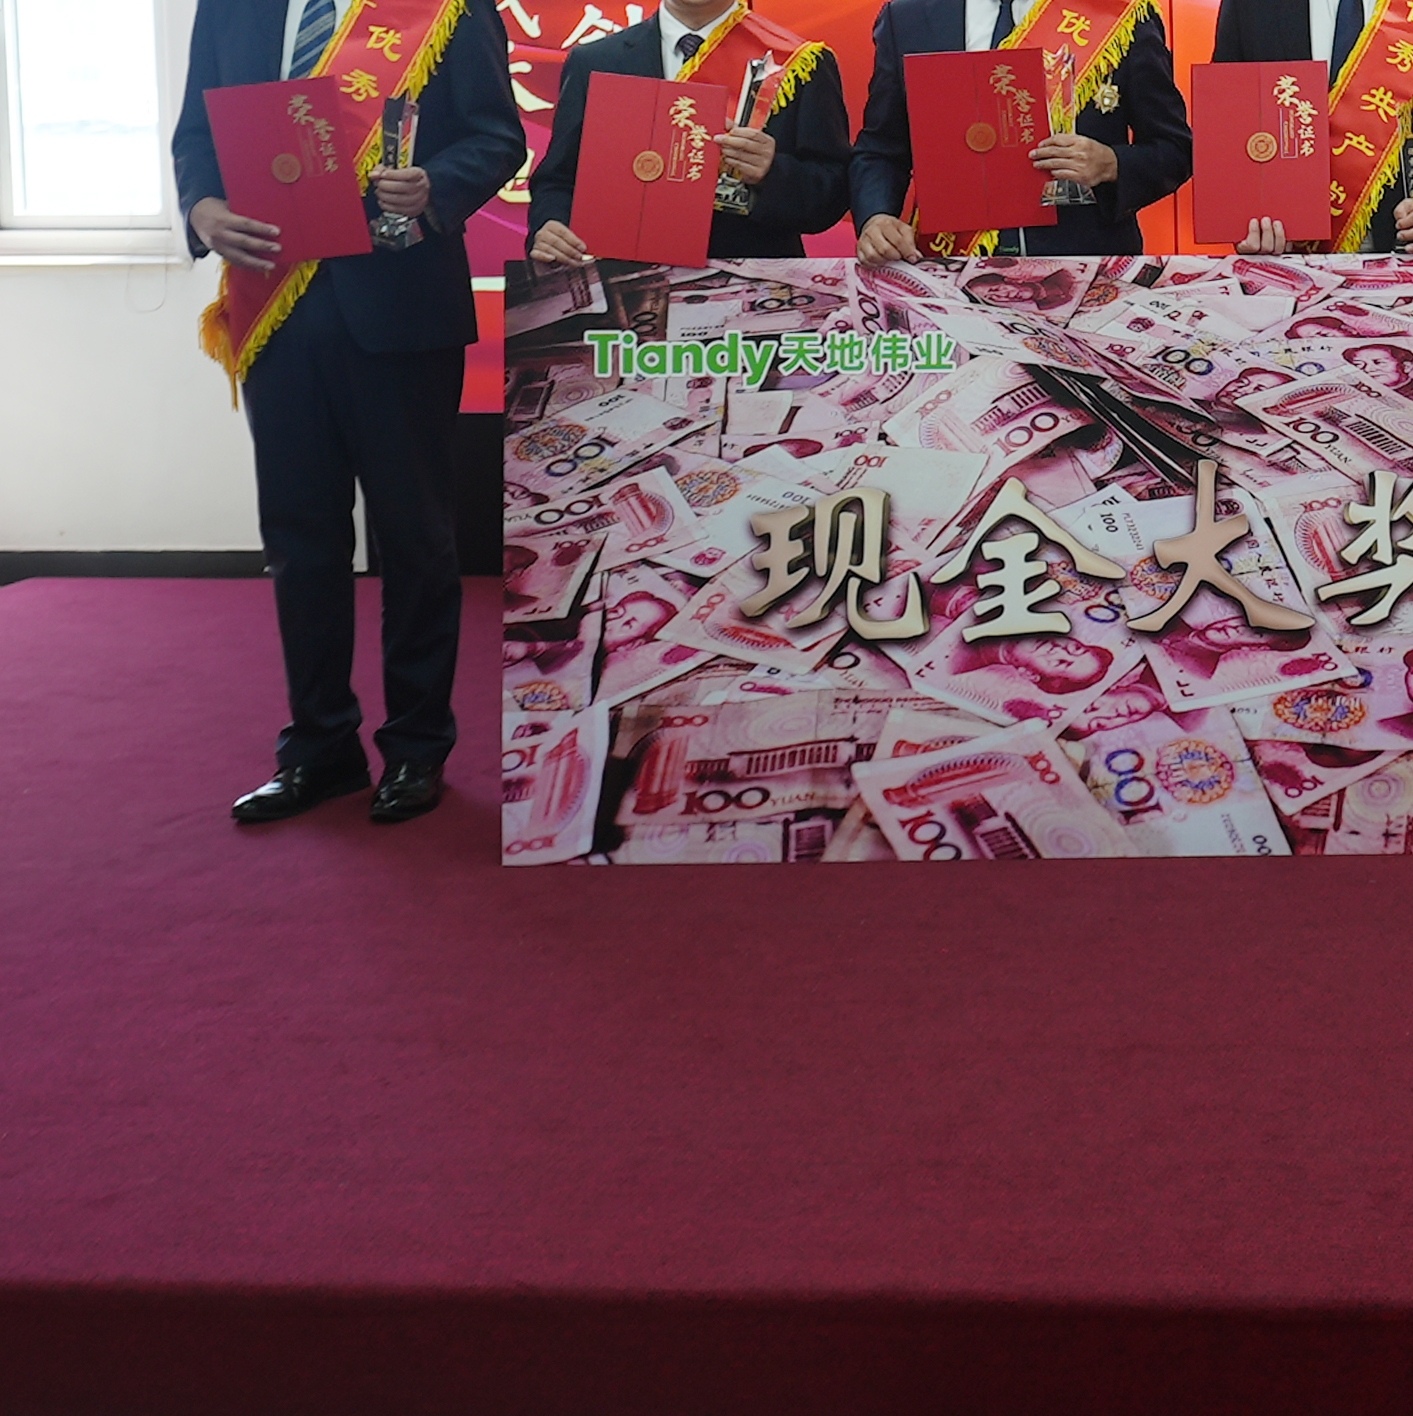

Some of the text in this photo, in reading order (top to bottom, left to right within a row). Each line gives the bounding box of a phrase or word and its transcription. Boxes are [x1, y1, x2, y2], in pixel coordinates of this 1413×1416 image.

[340, 25, 401, 102] 优秀
[587, 333, 954, 386] Tiandy 天地伟业
[1150, 346, 1214, 376] 100
[995, 412, 1059, 456] 100
[1286, 418, 1339, 446] 100
[854, 455, 889, 468] 100
[534, 494, 605, 524] 100
[1100, 513, 1118, 533] 100
[1026, 751, 1060, 784] 100
[678, 786, 770, 815] 100
[1285, 776, 1324, 798] 100
[900, 811, 961, 861] 100
